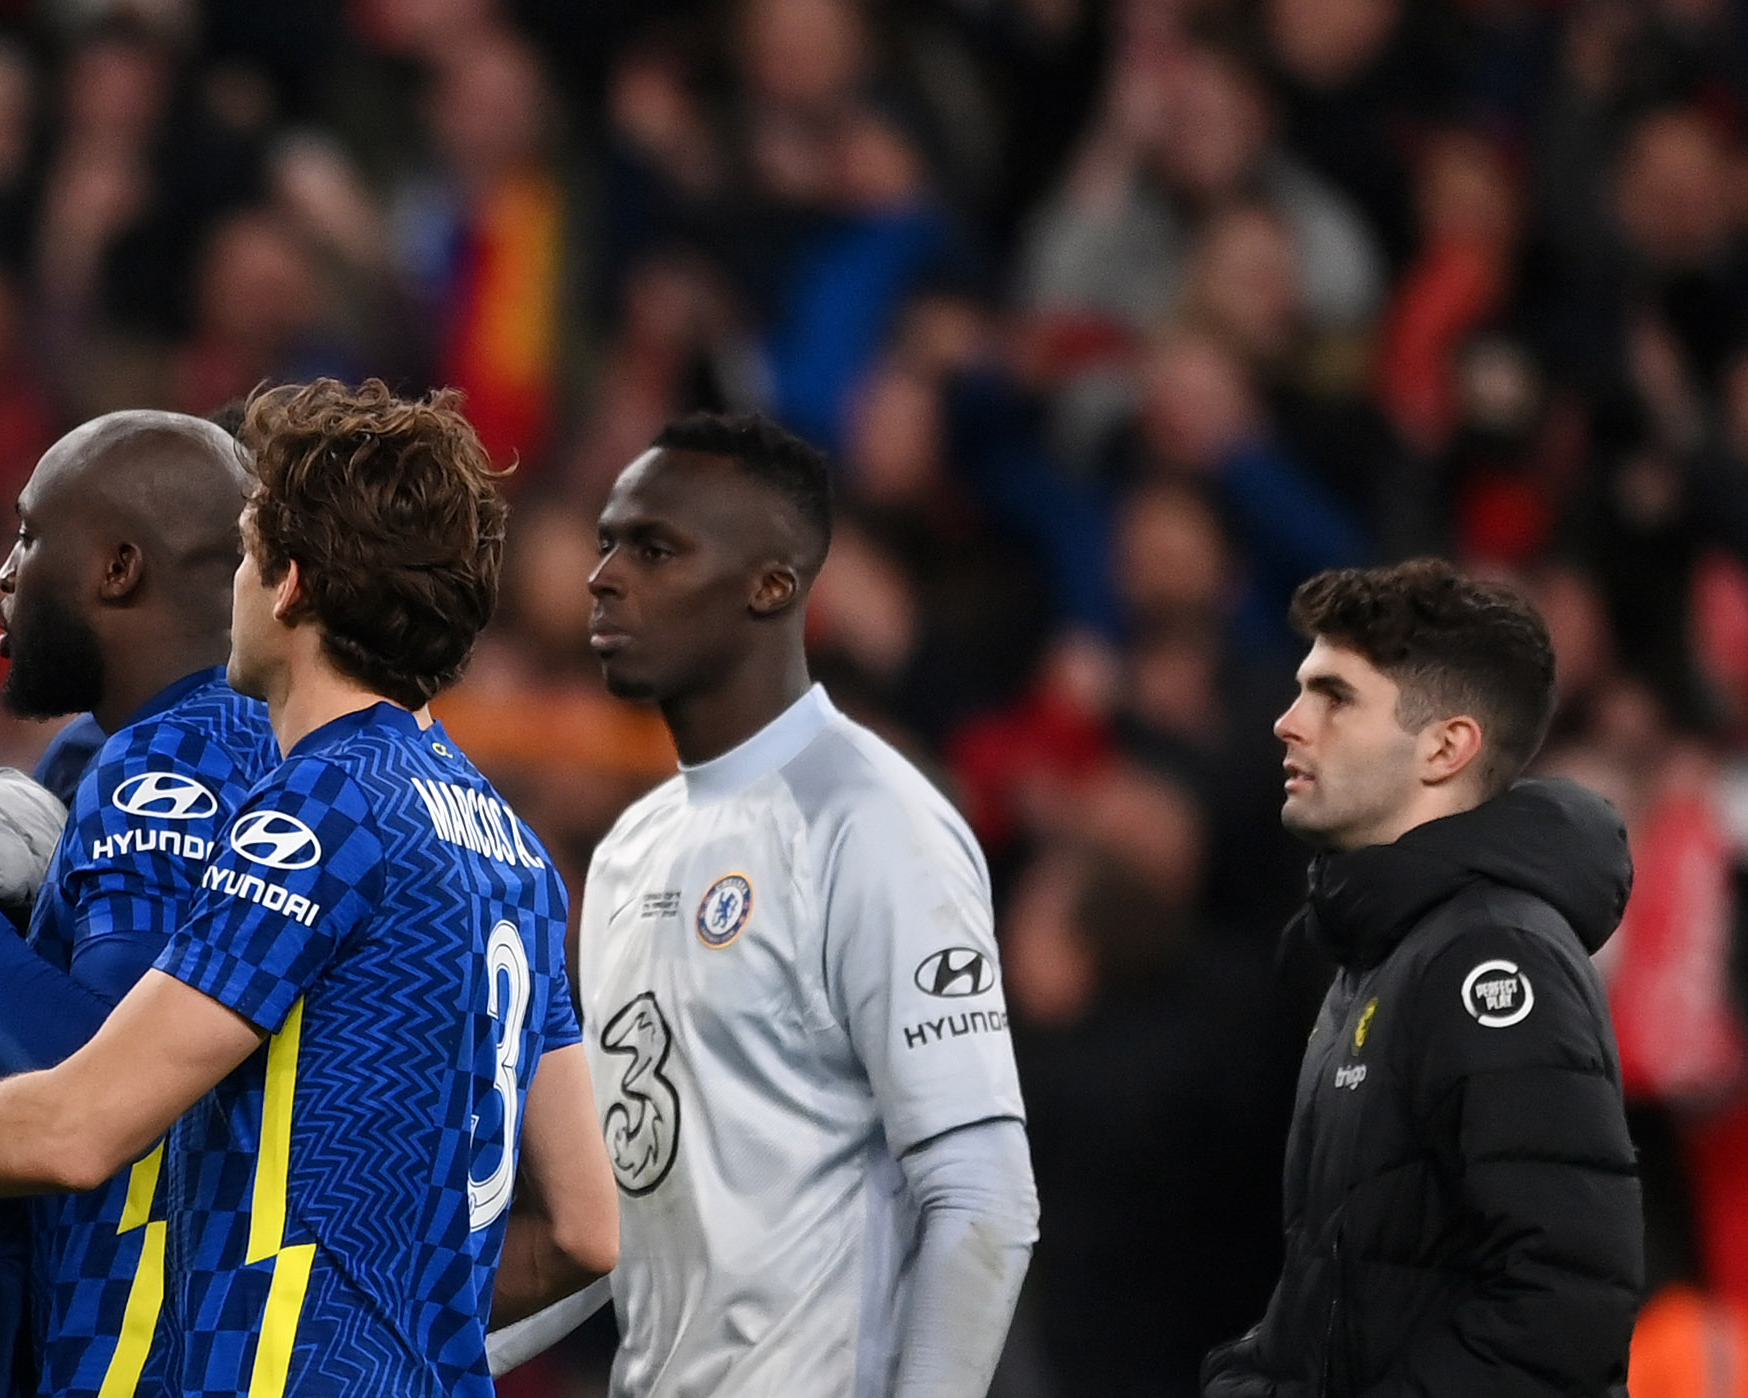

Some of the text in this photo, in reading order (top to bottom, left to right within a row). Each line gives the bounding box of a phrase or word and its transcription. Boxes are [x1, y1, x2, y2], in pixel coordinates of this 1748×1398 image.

[411, 777, 545, 869] MARCOS A.
[93, 829, 214, 860] HYUND
[1475, 979, 1517, 999] PERFECT
[1486, 992, 1514, 1010] PLAY
[468, 919, 531, 1233] 3
